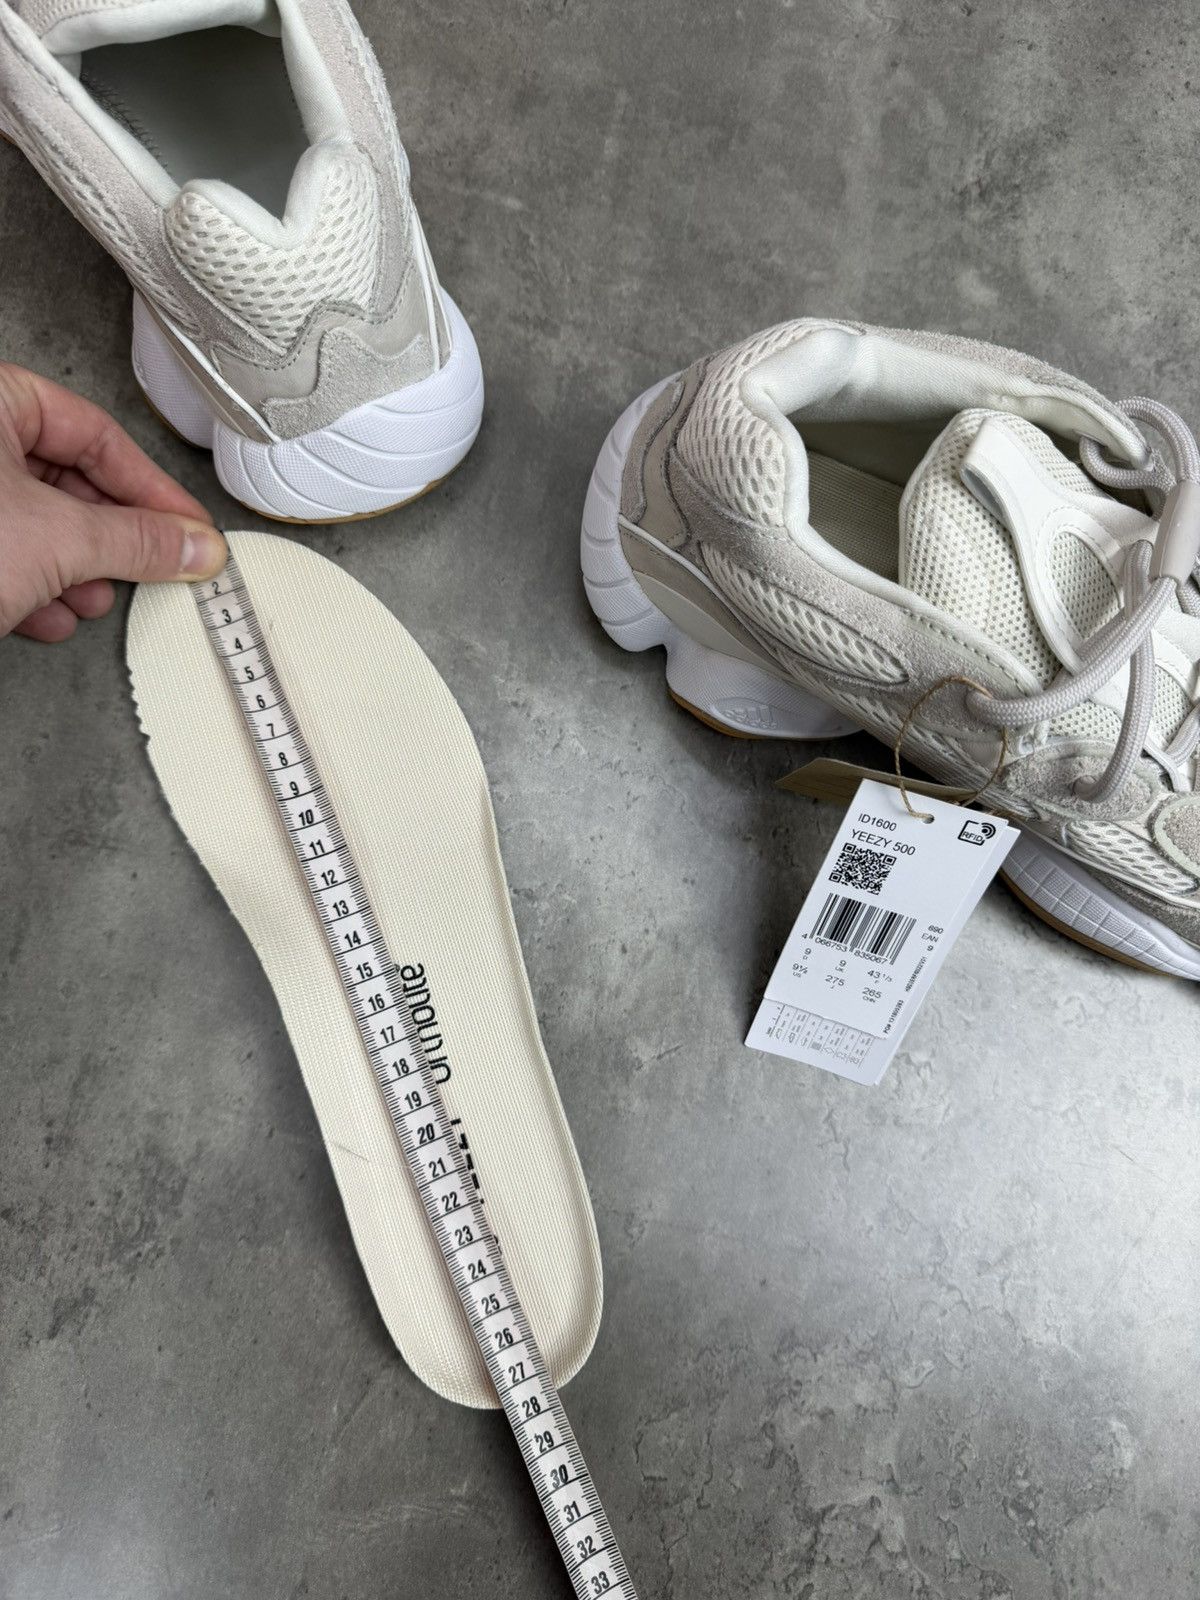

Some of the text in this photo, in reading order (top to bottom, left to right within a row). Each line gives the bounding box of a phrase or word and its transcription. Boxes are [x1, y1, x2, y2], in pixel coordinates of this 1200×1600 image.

[211, 581, 221, 594] 2
[222, 609, 232, 623] 3
[234, 637, 242, 651] 4
[244, 666, 254, 680] 5
[256, 694, 266, 708] 6
[266, 723, 275, 736] 7
[278, 752, 288, 766] 8
[290, 781, 299, 796] 9
[299, 809, 314, 826] 10
[858, 814, 897, 832] ID1600
[851, 829, 916, 856] YEEZY 500
[962, 831, 984, 842] RFID
[309, 839, 326, 856] 11
[321, 870, 338, 886] 12
[333, 900, 350, 916] 13
[344, 930, 362, 948] 14
[922, 933, 938, 942] EAN
[815, 937, 848, 952] 066753
[854, 950, 887, 964] 835067
[356, 962, 373, 979] 15
[868, 970, 880, 978] 43
[825, 975, 844, 986] 275
[862, 987, 882, 998] 265
[368, 994, 385, 1012] 16
[380, 1026, 395, 1044] 17
[392, 1058, 410, 1075] 18
[405, 1091, 422, 1109] 19
[418, 1123, 436, 1142] 20
[429, 1158, 446, 1178] 21
[442, 1191, 460, 1211] 22
[455, 1225, 473, 1245] 23
[468, 1258, 486, 1277] 24
[482, 1295, 500, 1314] 25
[495, 1328, 514, 1348] 26
[508, 1362, 526, 1382] 27
[522, 1396, 541, 1416] 28
[535, 1430, 555, 1450] 29
[550, 1465, 569, 1486] 30
[564, 1500, 582, 1522] 31
[577, 1536, 596, 1558] 32
[591, 1571, 610, 1594] 33
